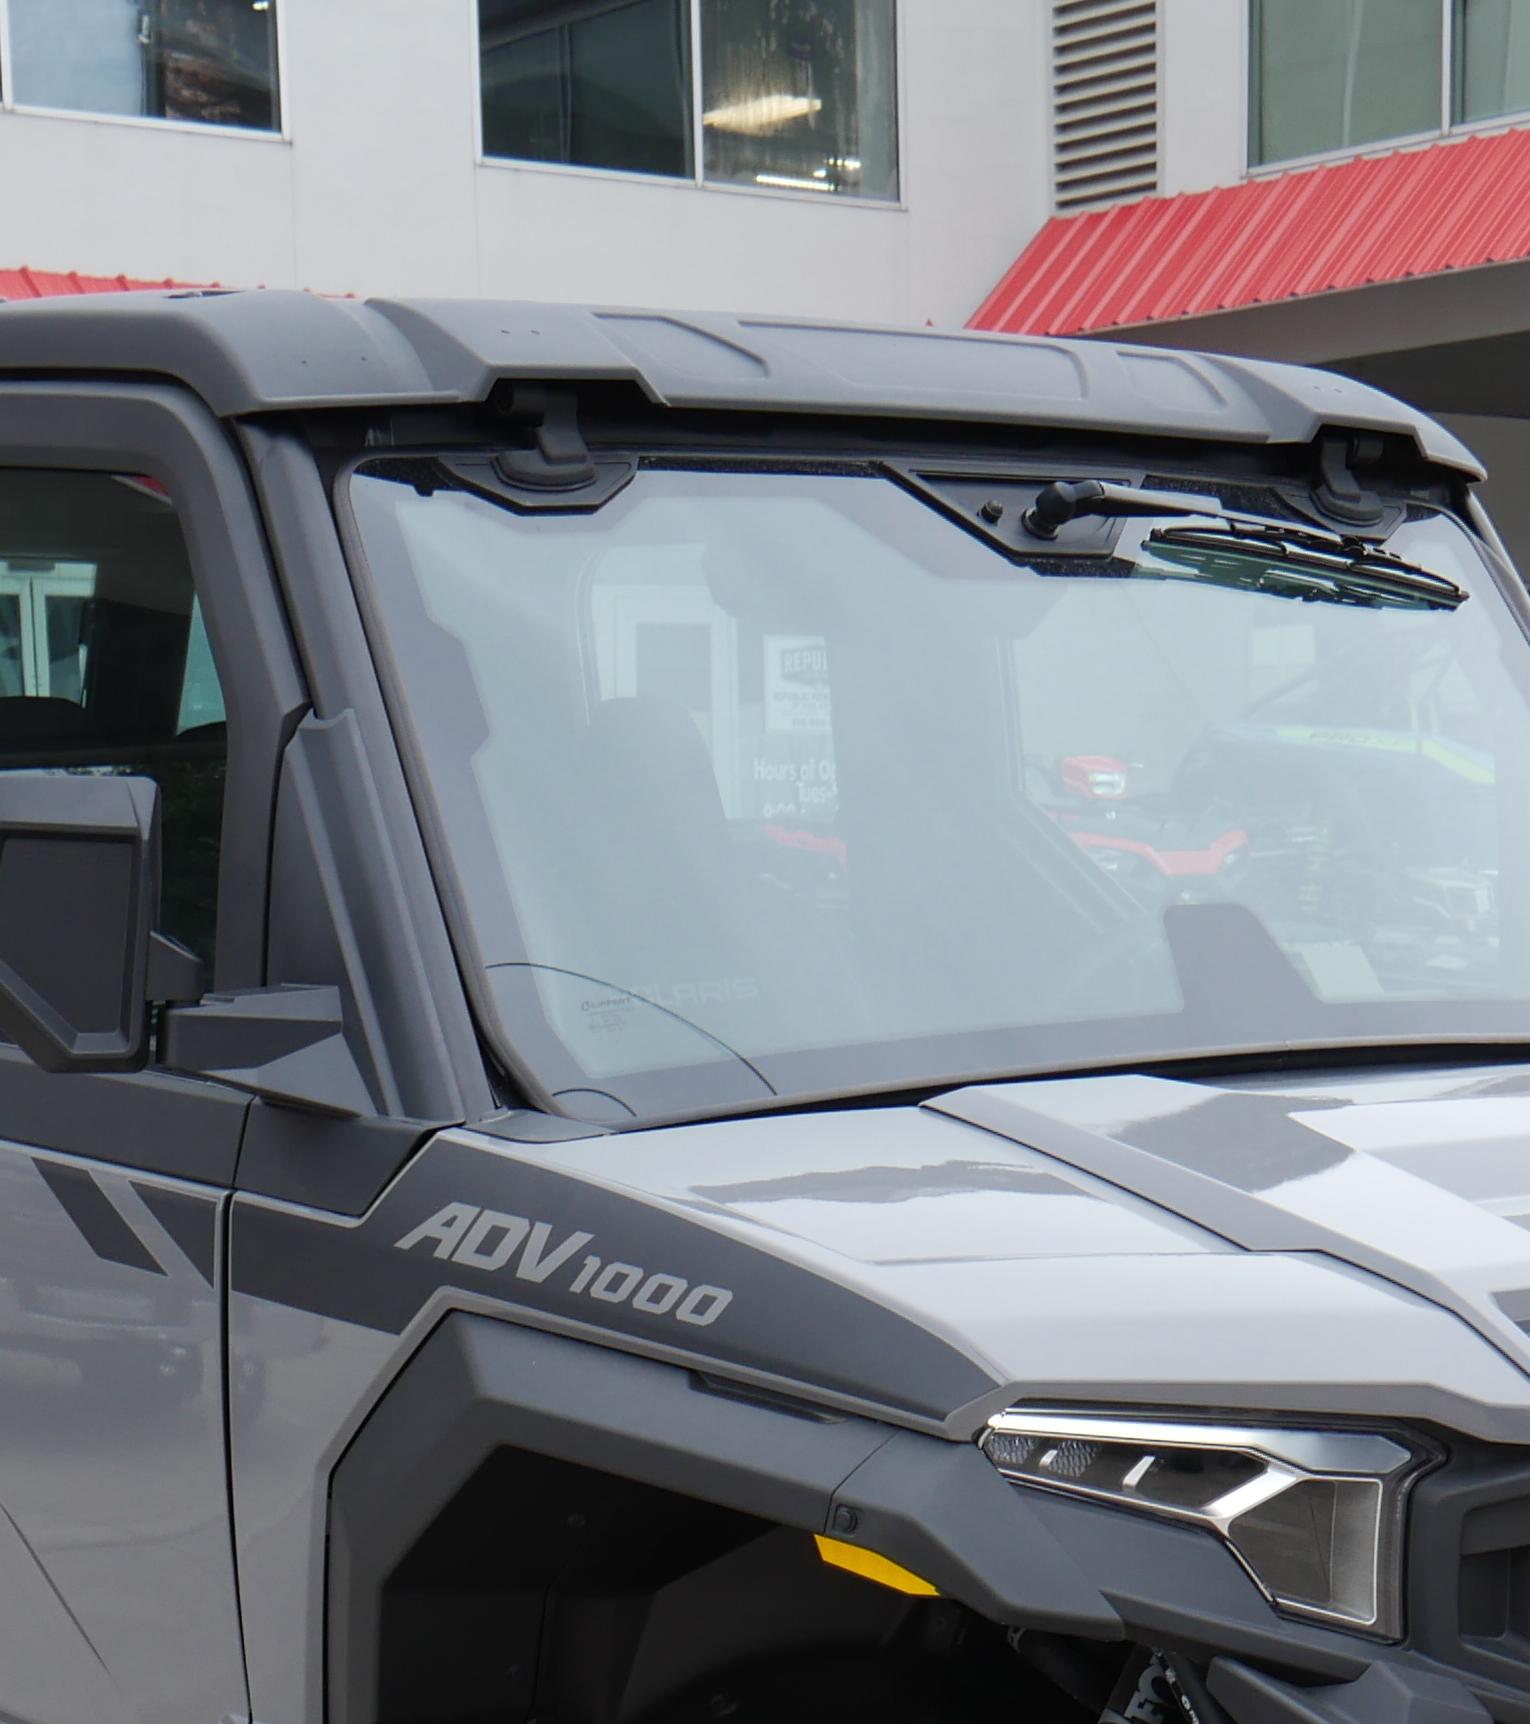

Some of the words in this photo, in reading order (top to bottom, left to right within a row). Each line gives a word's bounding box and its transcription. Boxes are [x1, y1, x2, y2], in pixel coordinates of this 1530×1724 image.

[755, 759, 796, 780] Hours
[800, 759, 814, 780] of
[393, 1201, 596, 1284] ADV
[569, 1253, 734, 1327] 1000
